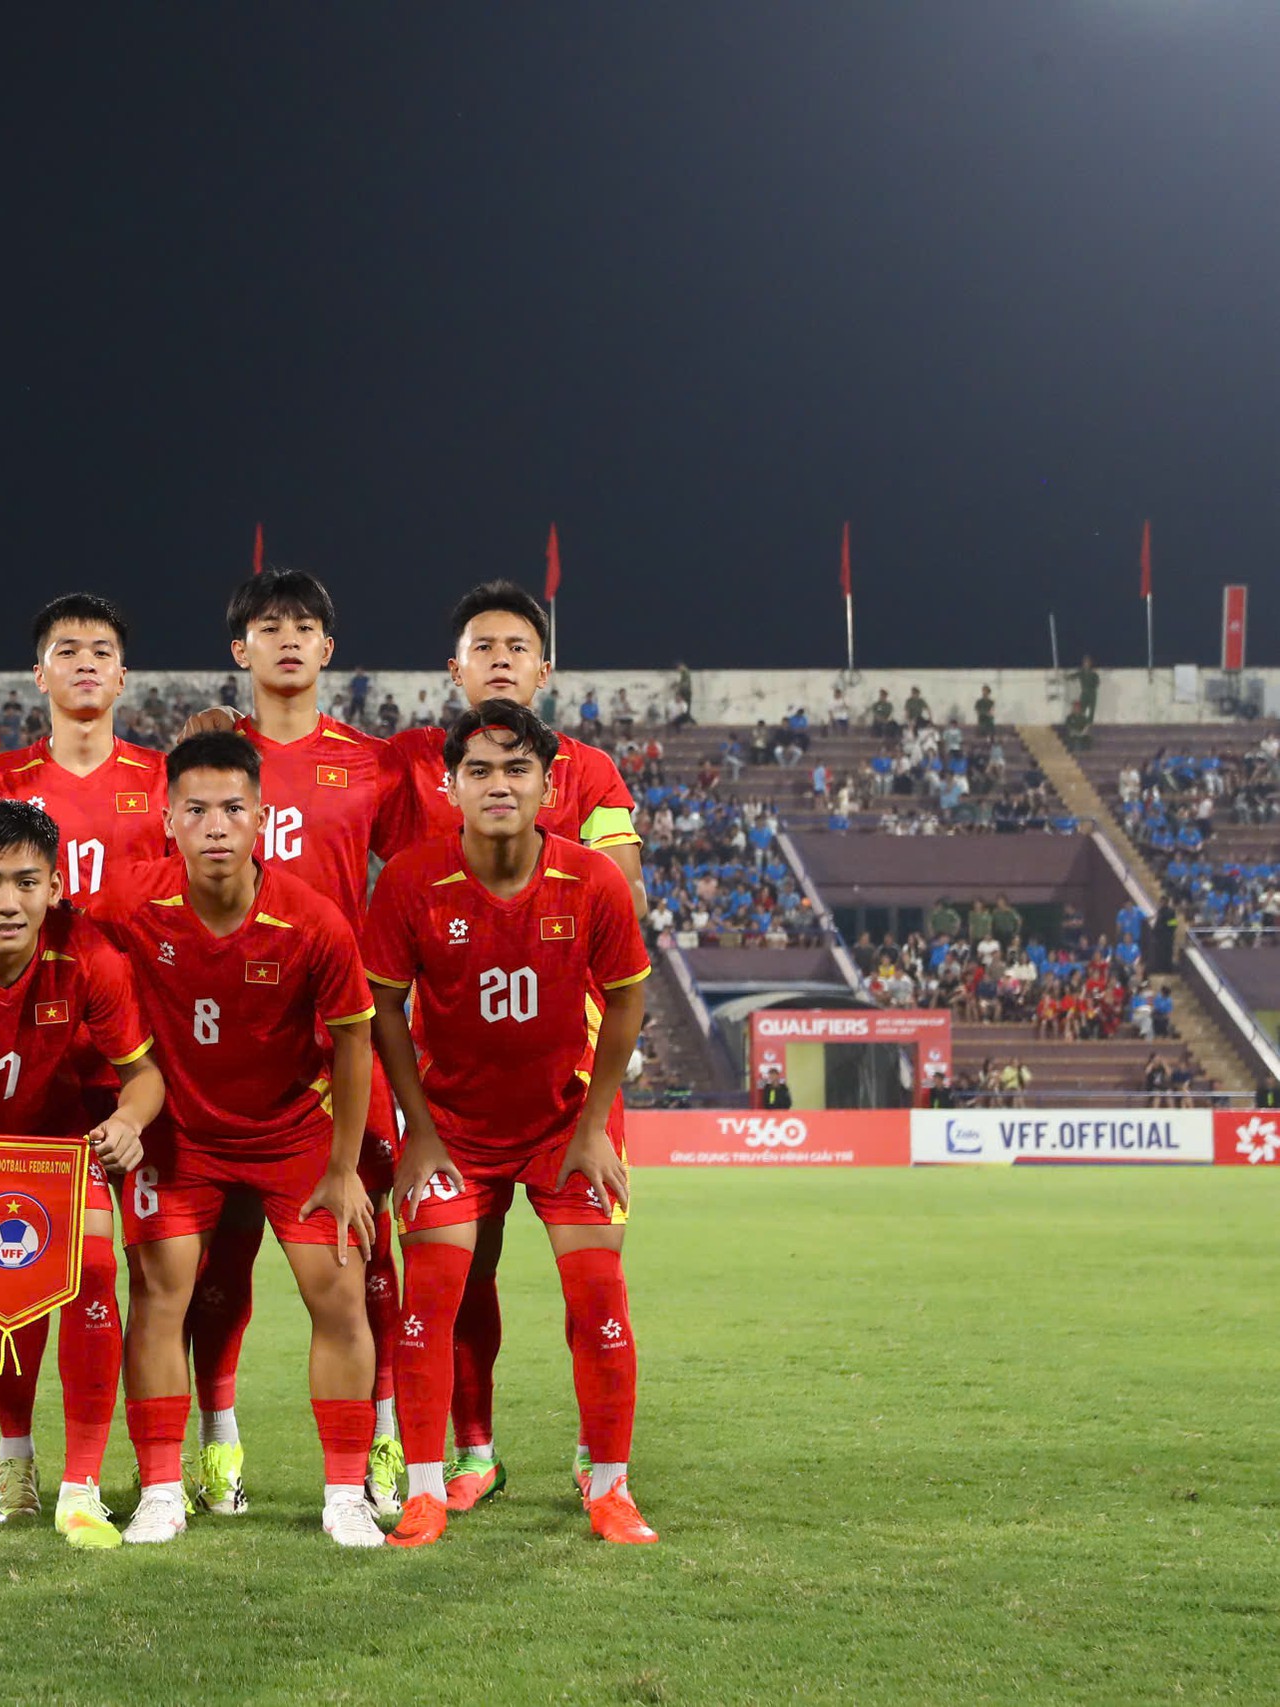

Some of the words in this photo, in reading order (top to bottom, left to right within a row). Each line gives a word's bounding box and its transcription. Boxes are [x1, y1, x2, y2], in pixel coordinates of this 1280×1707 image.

[264, 804, 303, 861] 12
[67, 838, 105, 895] 17
[479, 966, 538, 1023] 20
[193, 998, 220, 1045] 8
[758, 1018, 869, 1036] QUALIFIERS
[717, 1117, 807, 1147] TV360
[999, 1122, 1180, 1149] VFF.OFFICIAL
[28, 1160, 71, 1174] FEDERATION
[133, 1166, 159, 1220] 8
[1, 1249, 24, 1259] VFF
